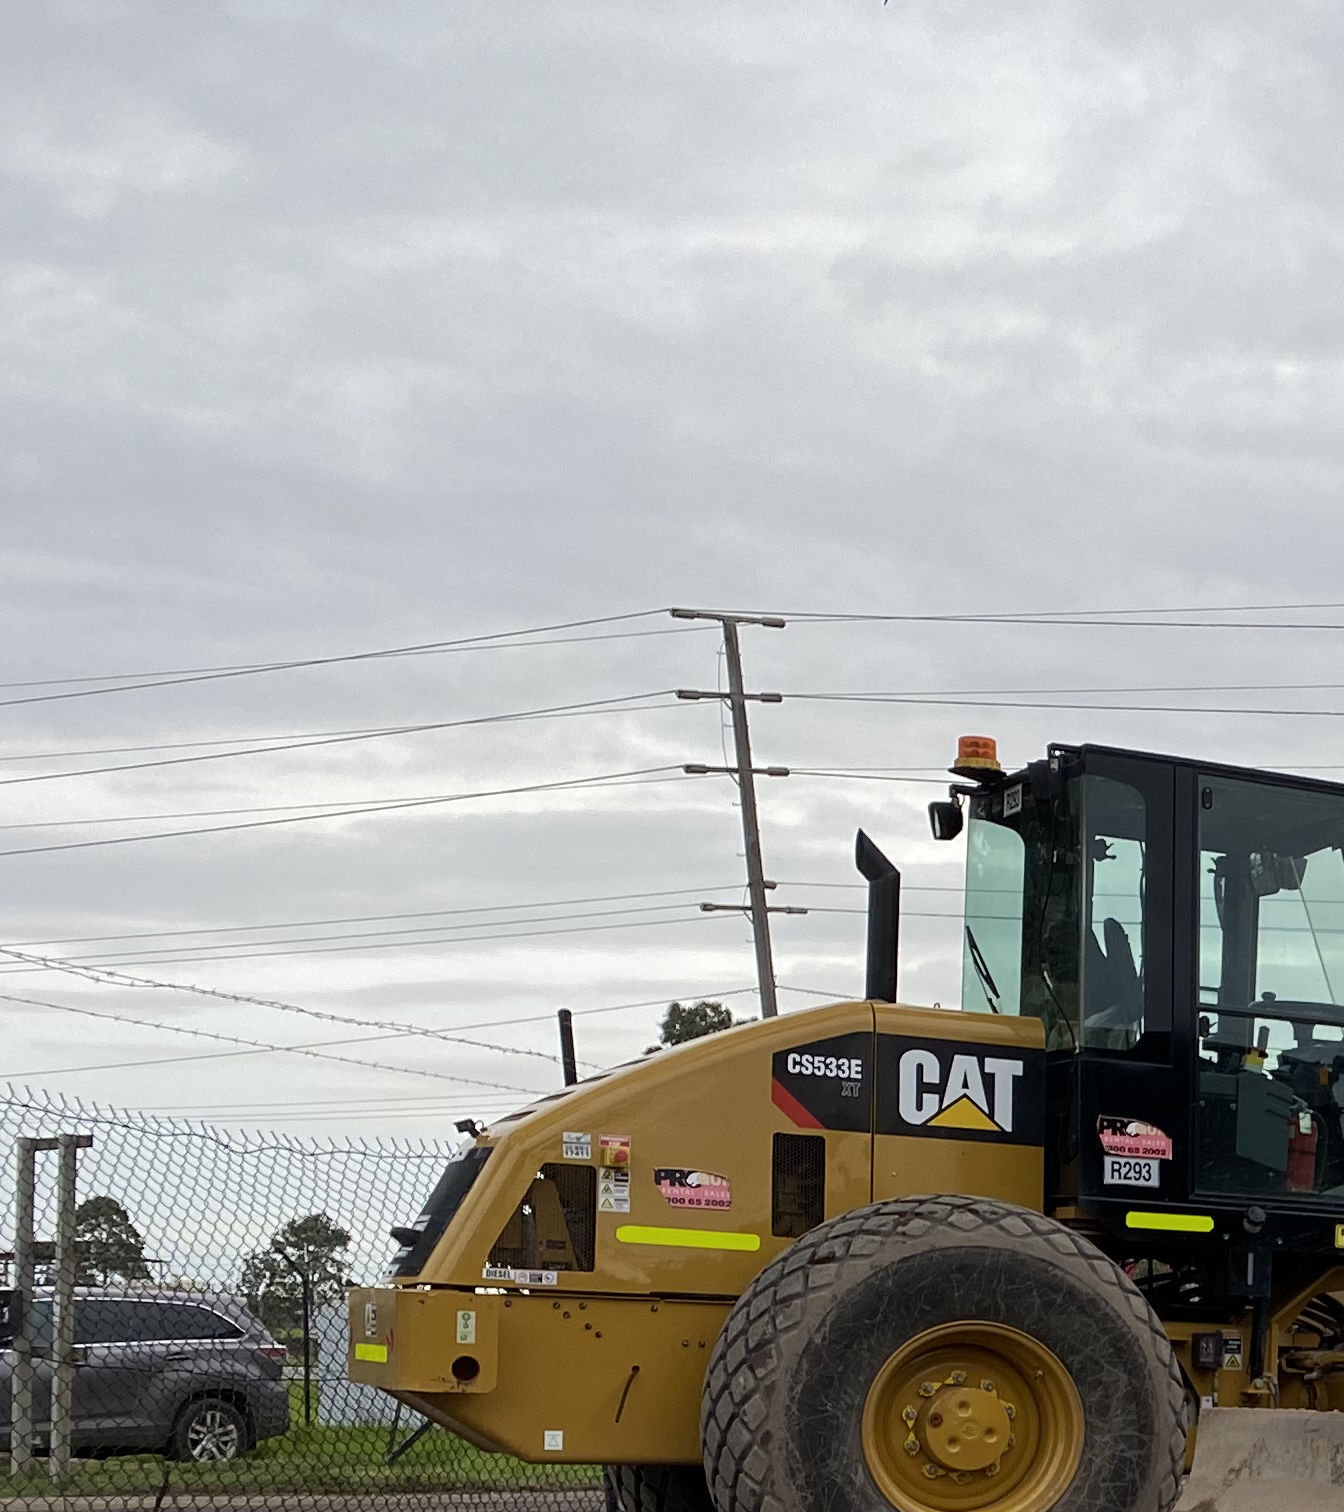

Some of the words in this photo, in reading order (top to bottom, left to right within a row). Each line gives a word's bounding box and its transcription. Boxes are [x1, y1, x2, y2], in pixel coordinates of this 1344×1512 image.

[787, 1053, 862, 1079] CS533E
[840, 1081, 861, 1098] XT
[898, 1049, 1024, 1133] CAT
[1110, 1160, 1152, 1182] R293
[687, 1198, 702, 1206] 65
[703, 1199, 732, 1208] 2002
[485, 1269, 511, 1279] DIESEL
